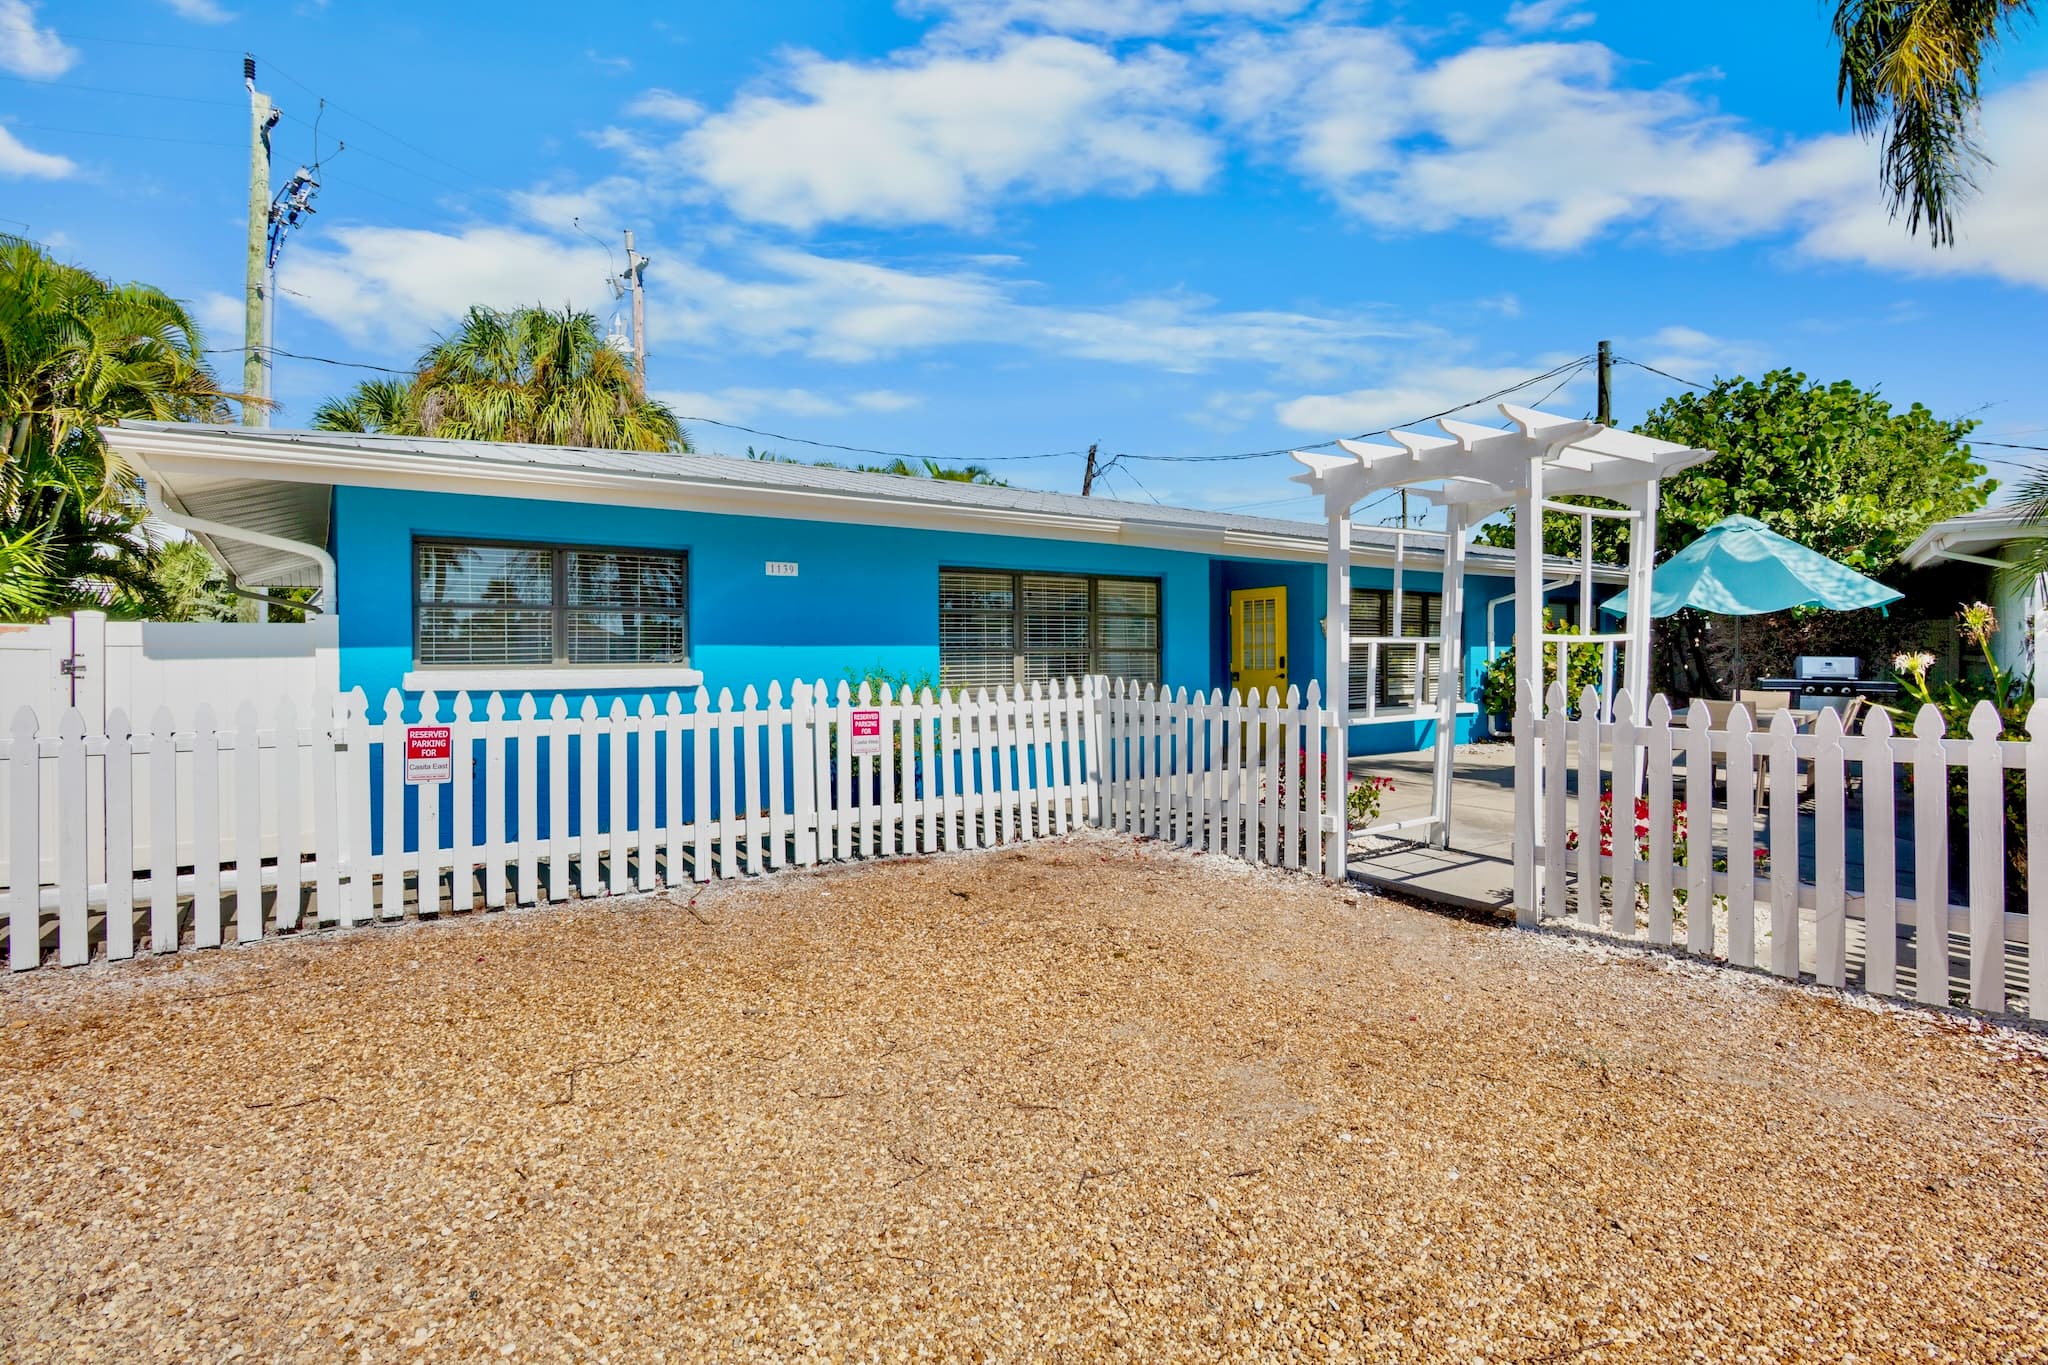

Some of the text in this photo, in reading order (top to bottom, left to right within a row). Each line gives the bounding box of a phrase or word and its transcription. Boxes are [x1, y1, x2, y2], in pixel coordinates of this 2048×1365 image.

[771, 564, 794, 574] 1139
[853, 713, 878, 721] RESERVED
[855, 720, 878, 728] PARKING
[410, 730, 449, 739] RESERVED
[861, 727, 872, 735] FOR
[411, 739, 447, 748] PARKING
[421, 749, 437, 757] FOR
[409, 762, 448, 771] Casita East
